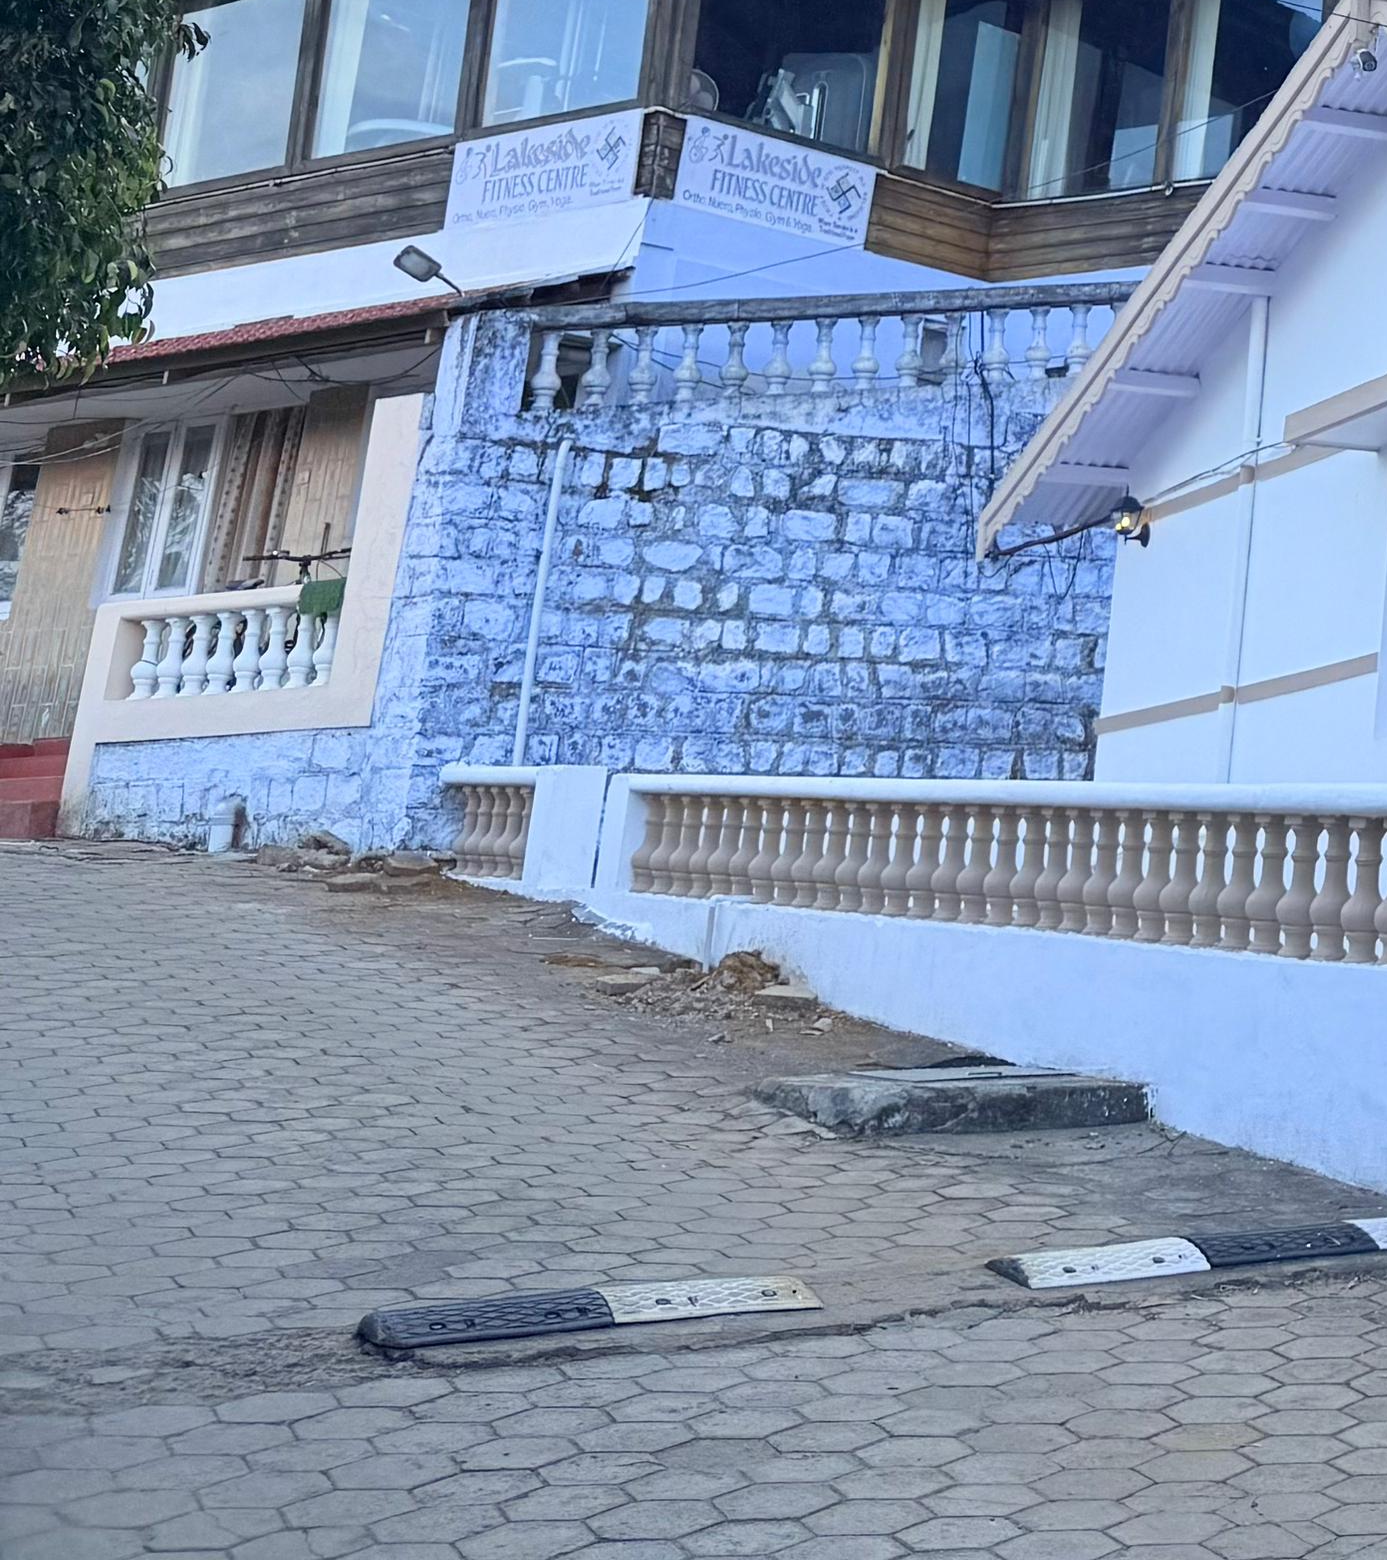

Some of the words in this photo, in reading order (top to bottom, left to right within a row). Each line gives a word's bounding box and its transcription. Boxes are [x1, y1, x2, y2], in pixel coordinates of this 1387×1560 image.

[490, 127, 592, 176] Lakeside
[725, 134, 822, 188] Lakeside
[481, 168, 537, 205] FITNESS
[537, 163, 591, 195] CENTRE
[711, 168, 767, 205] FITNESS
[769, 183, 821, 217] CENTRE
